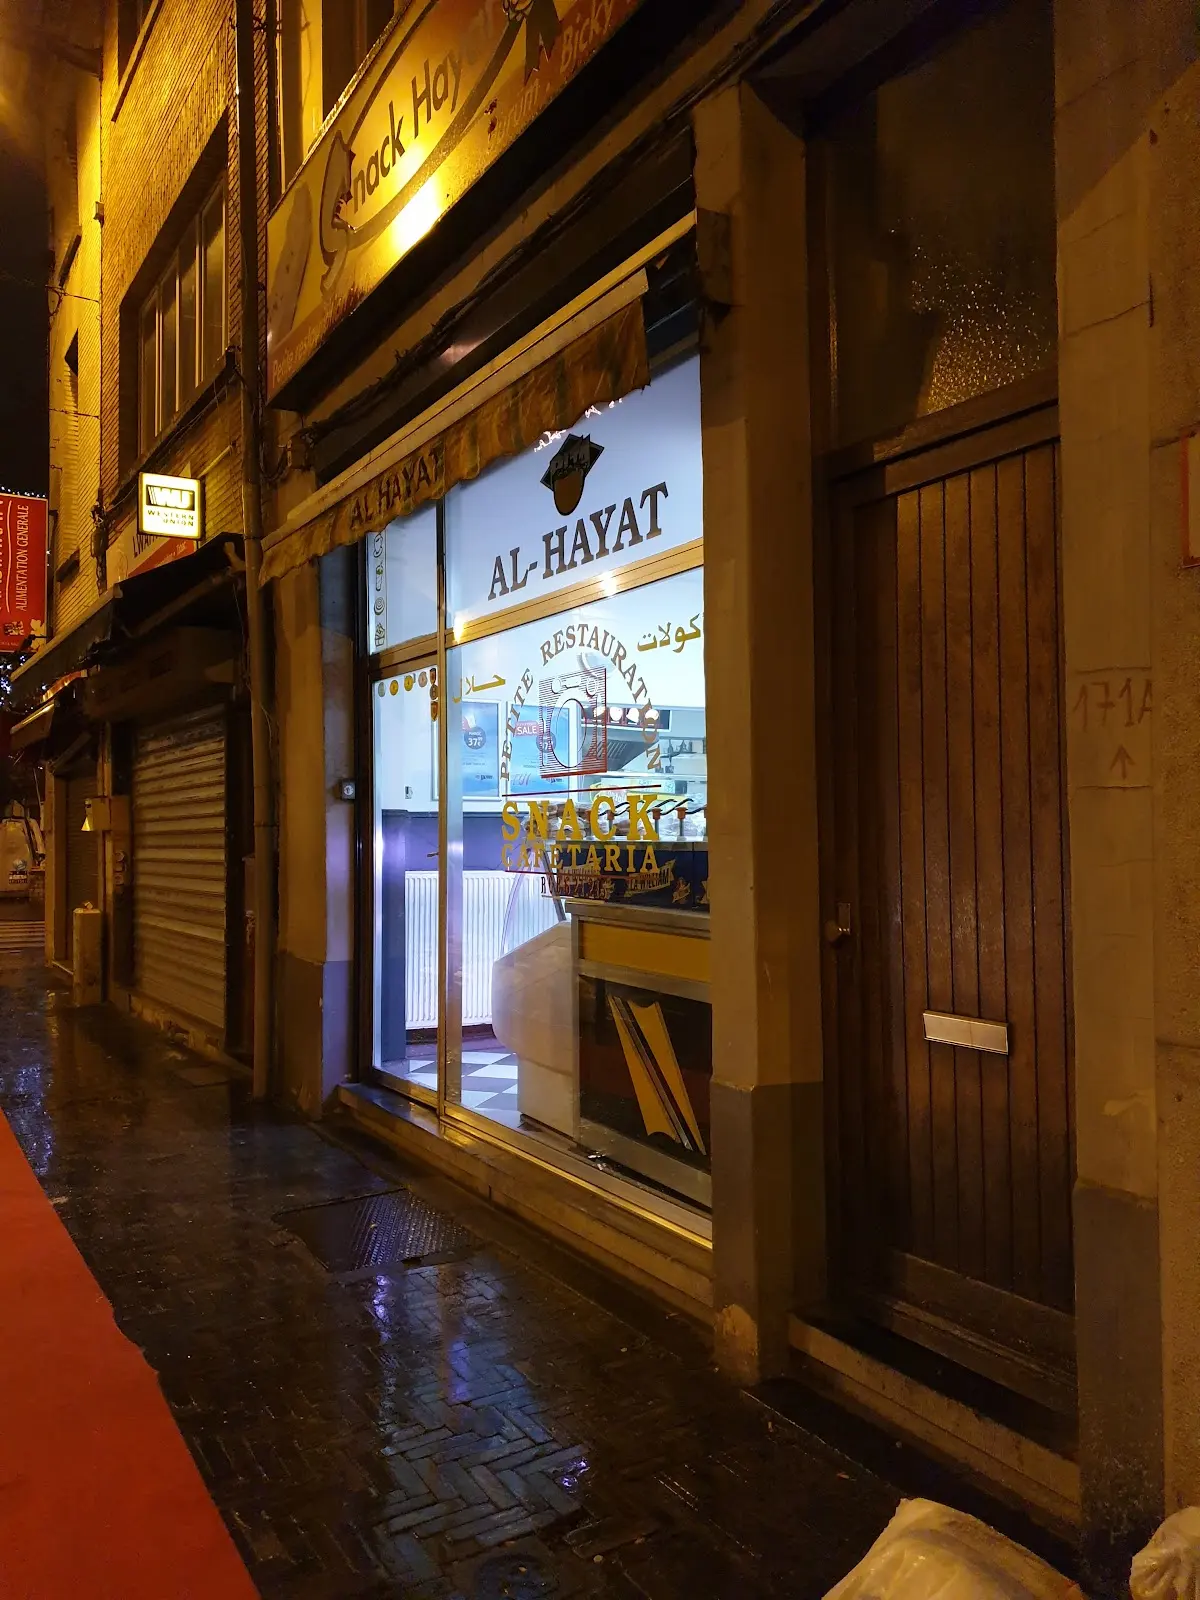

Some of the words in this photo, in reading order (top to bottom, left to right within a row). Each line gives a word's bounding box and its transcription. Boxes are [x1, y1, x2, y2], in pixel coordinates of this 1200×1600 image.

[378, 446, 441, 513] HAYAT
[17, 504, 29, 548] GENERALE
[147, 509, 195, 521] WESTERN
[162, 517, 195, 527] UNION
[487, 482, 669, 600] AL-HAYAT
[15, 549, 28, 612] ALIMENTATION
[500, 668, 534, 782] PETITE
[539, 623, 662, 770] RESTAURATION
[516, 725, 538, 736] SALE
[501, 793, 661, 842] SNACK
[501, 843, 661, 875] CAFETARIA
